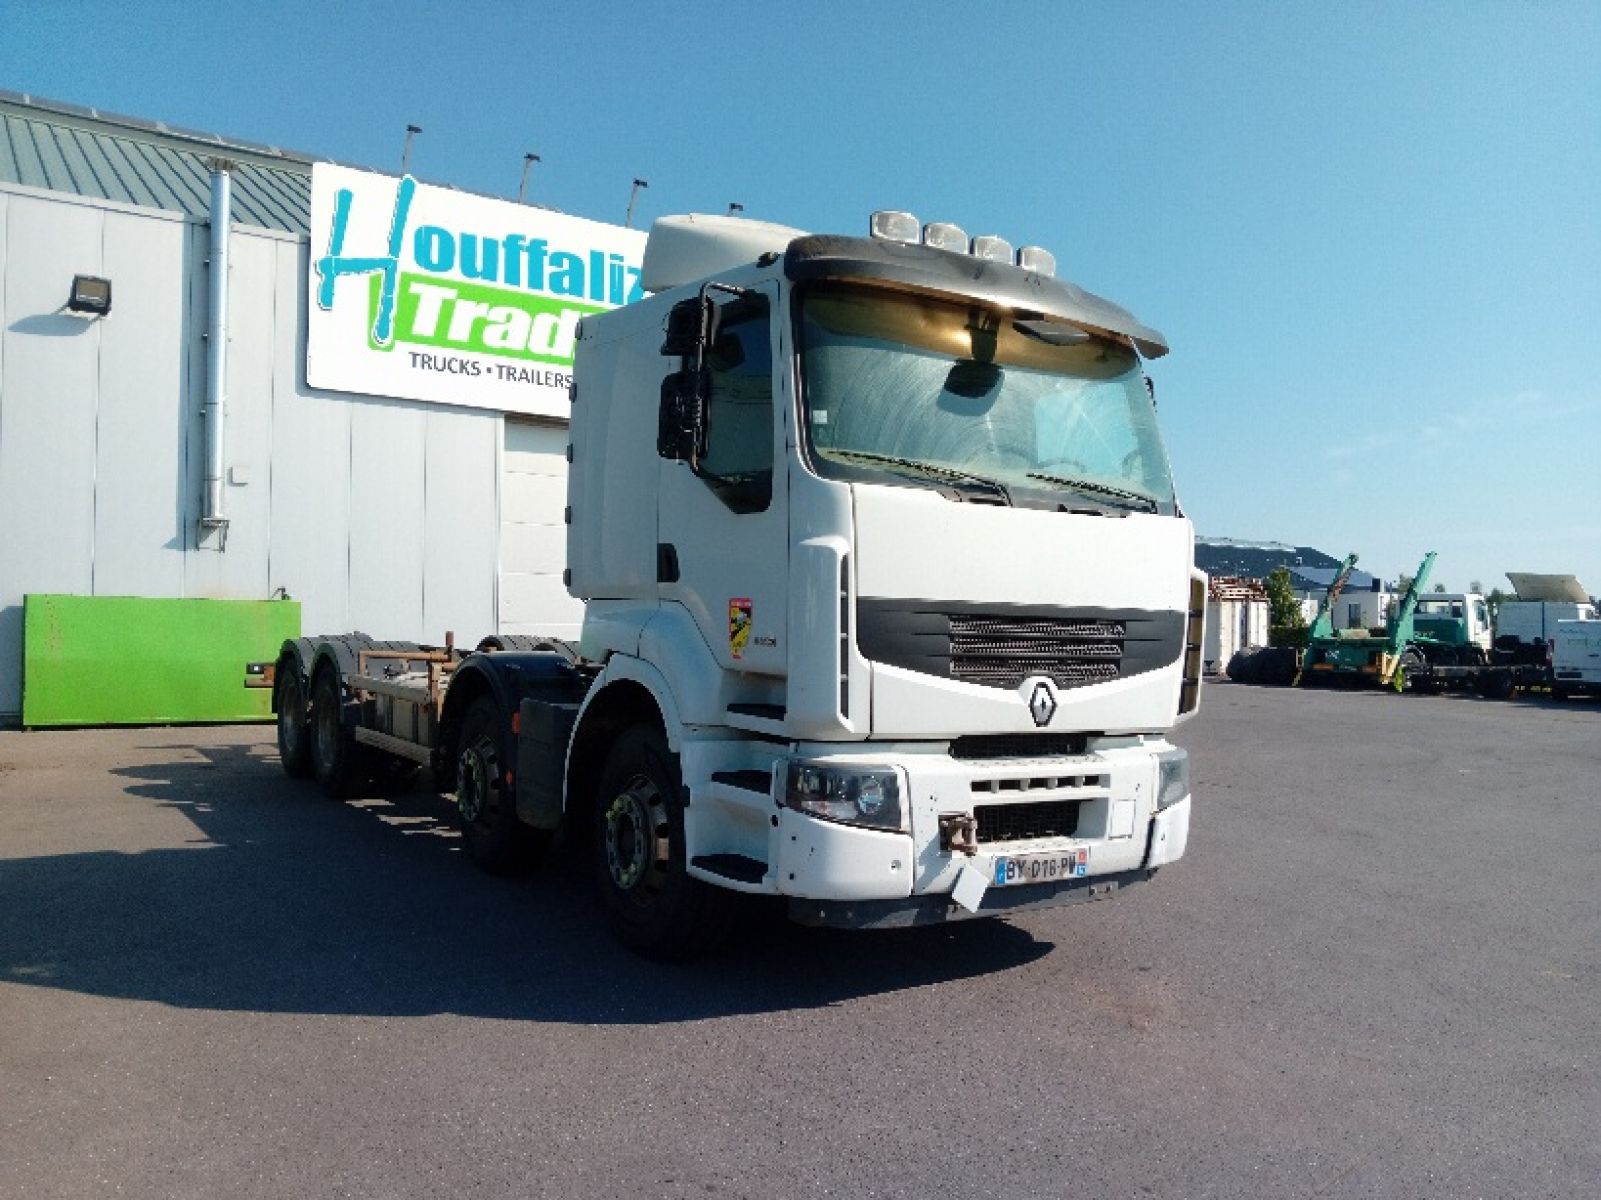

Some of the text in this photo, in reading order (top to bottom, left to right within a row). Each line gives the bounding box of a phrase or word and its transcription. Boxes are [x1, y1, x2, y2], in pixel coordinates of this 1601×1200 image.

[408, 281, 591, 359] Trad
[408, 351, 573, 389] TRUCKS TRAILERS
